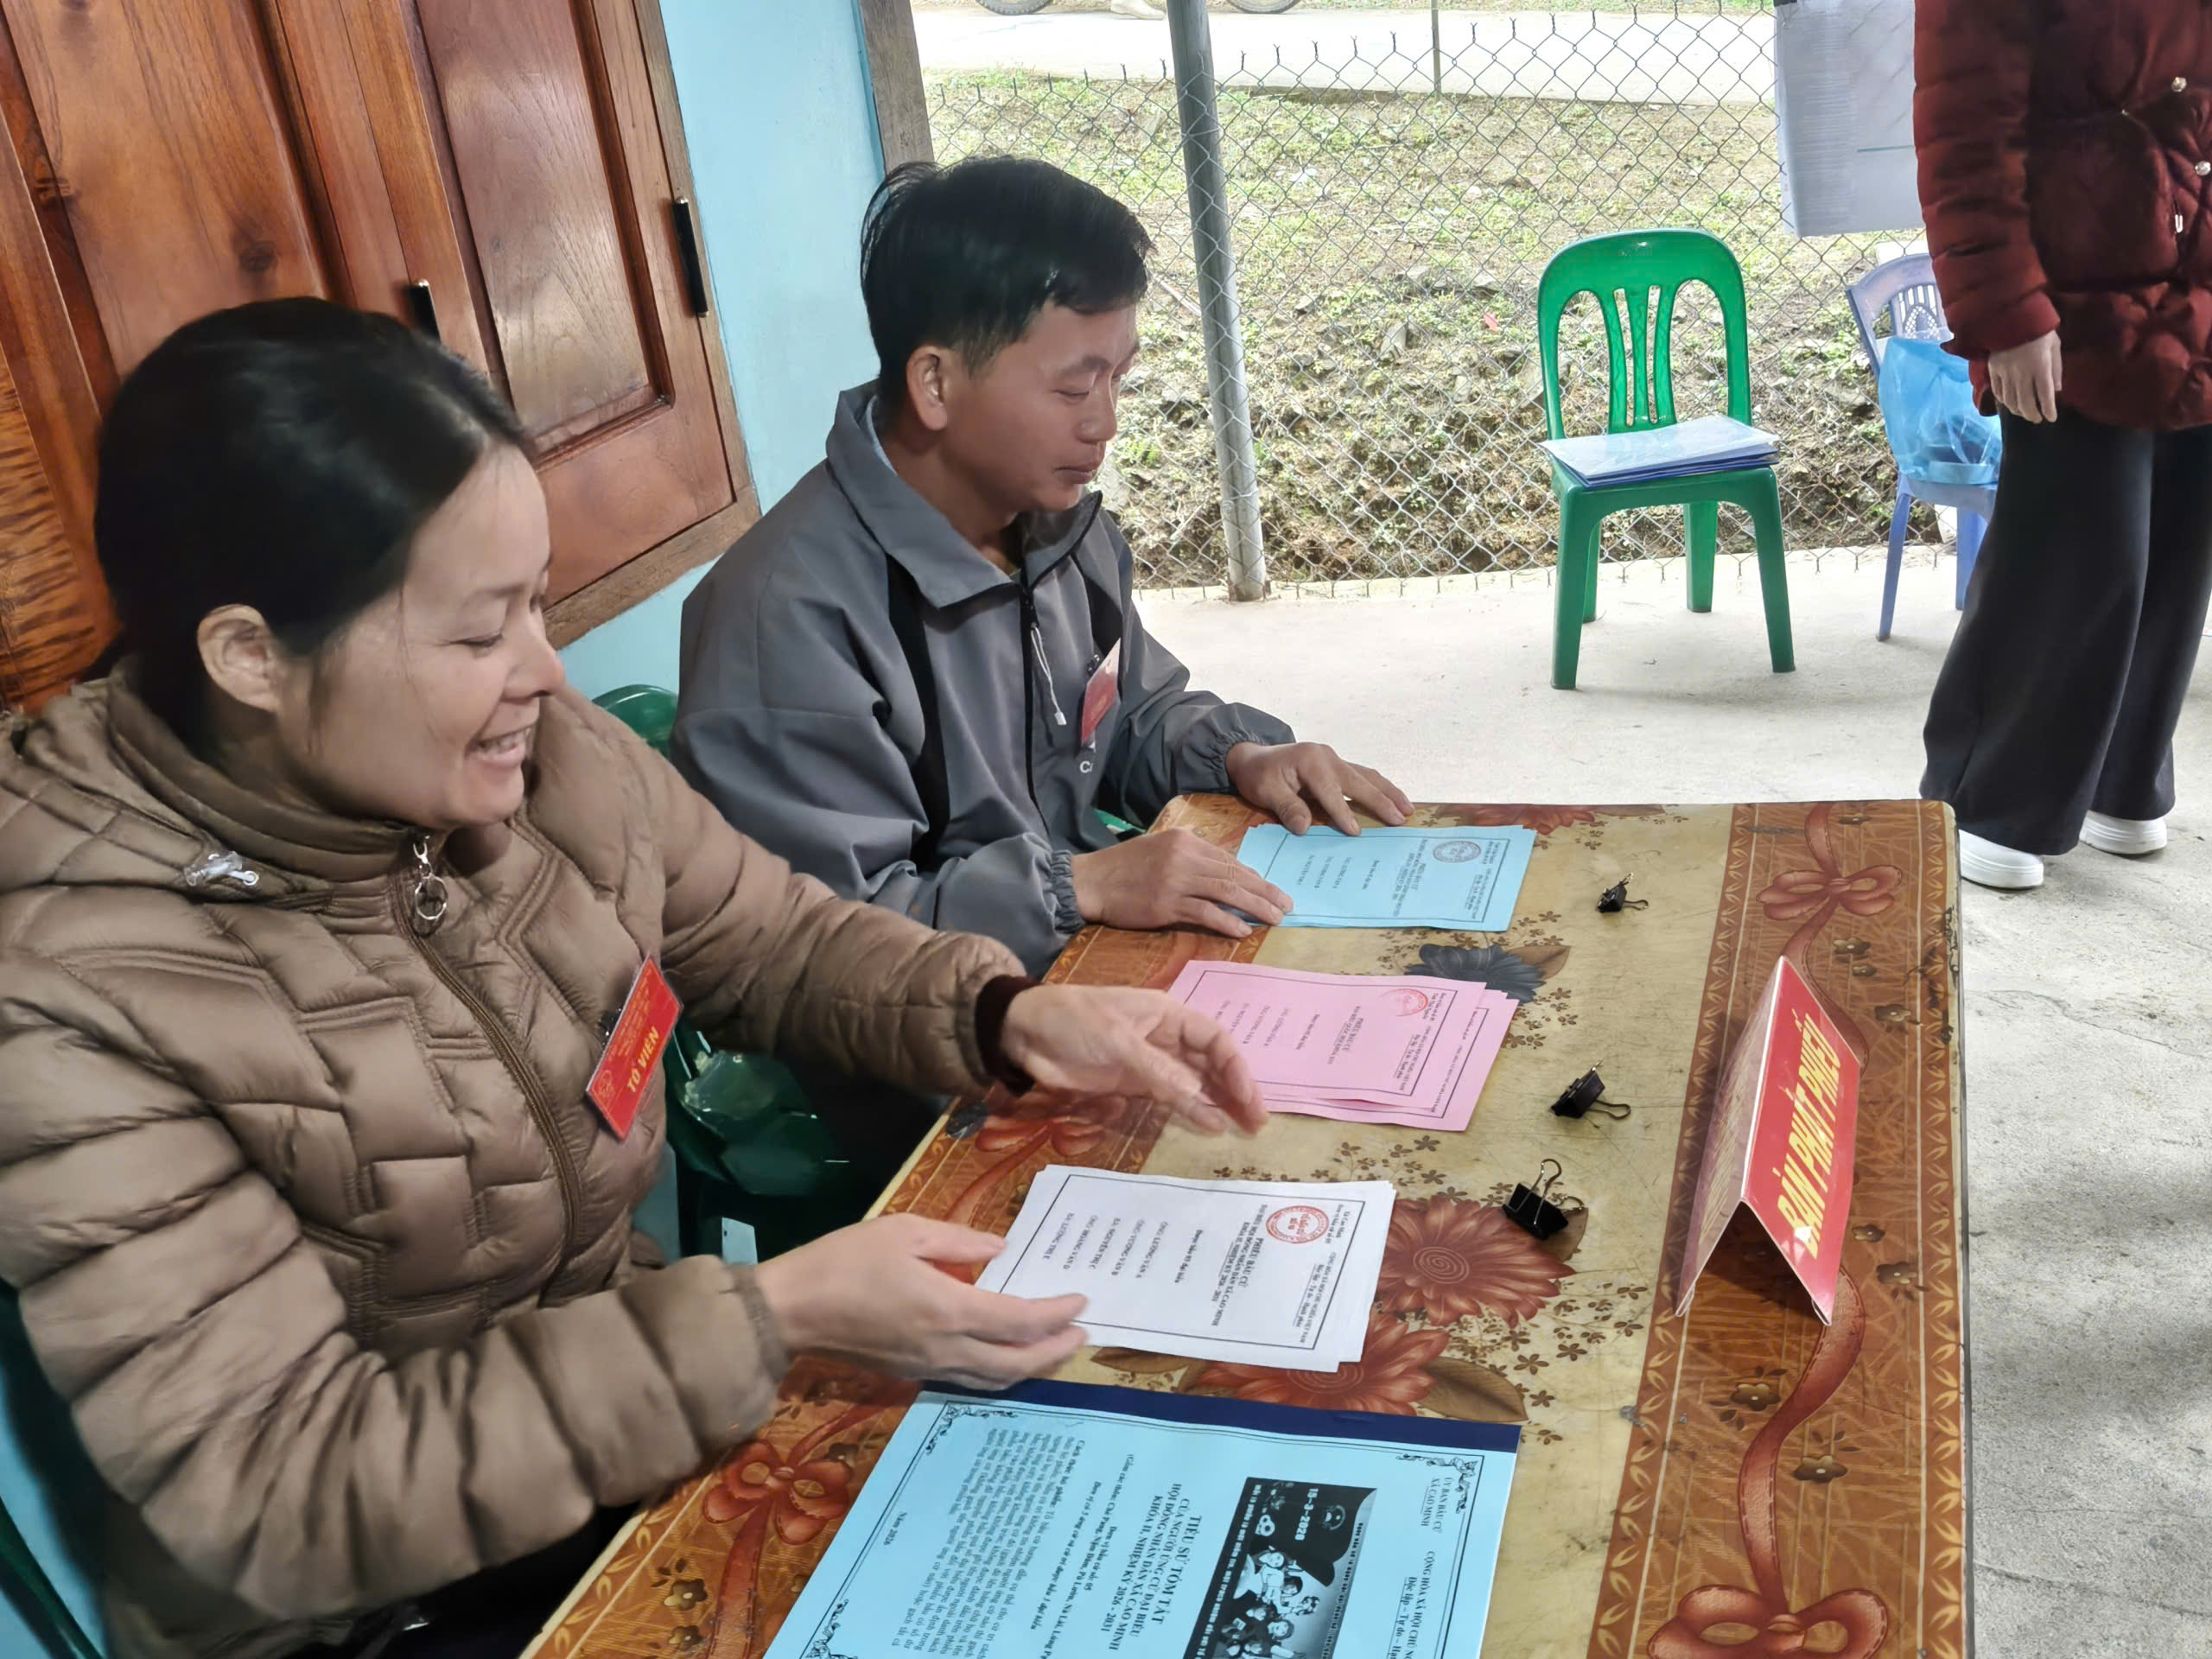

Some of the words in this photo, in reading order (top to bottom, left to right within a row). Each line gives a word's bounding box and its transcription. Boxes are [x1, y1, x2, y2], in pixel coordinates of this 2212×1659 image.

[1792, 1008, 1840, 1122] PHIẾU
[1785, 1082, 1834, 1192] PHÁT
[1772, 1154, 1825, 1259] BÀN
[1431, 1478, 1440, 1488] XÃ
[1443, 1477, 1453, 1486] ỦY
[1166, 1483, 1182, 1501] HỘI
[1427, 1489, 1436, 1504] CAO
[1440, 1488, 1449, 1503] BAN
[1143, 1495, 1165, 1522] KHÓA
[1155, 1503, 1175, 1529] ĐỒNG
[1174, 1497, 1192, 1517] CỦA
[1421, 1505, 1431, 1526] MINH
[1435, 1504, 1446, 1519] BẦU
[1161, 1520, 1183, 1551] NGƯỜI
[1180, 1514, 1205, 1544] TIỂU
[1432, 1520, 1443, 1533] CỬ
[1126, 1536, 1147, 1567] NHIỆM
[1145, 1532, 1165, 1558] NHÂN
[1154, 1554, 1170, 1574] ỨNG
[1173, 1546, 1193, 1564] SỬ
[1422, 1550, 1434, 1575] CỘNG
[1120, 1570, 1136, 1584] KỲ
[1135, 1560, 1154, 1580] DÂN
[1129, 1582, 1146, 1596] XÃ
[1146, 1576, 1163, 1592] CỬ
[1161, 1565, 1185, 1595] TÓM
[1404, 1576, 1416, 1591] Độc
[1419, 1577, 1430, 1596] HÒA
[1113, 1586, 1128, 1605] 2026
[1137, 1592, 1154, 1610] ĐẠI
[1400, 1592, 1413, 1605] lập
[1415, 1598, 1427, 1610] XÃ
[1119, 1598, 1137, 1619] CAO
[1150, 1598, 1173, 1624] TẮT
[1102, 1612, 1117, 1631] 2031
[1128, 1612, 1147, 1637] BIỂU
[1395, 1613, 1408, 1625] Tự
[1409, 1611, 1422, 1628] HỘI
[1108, 1622, 1128, 1650] MINH
[1395, 1626, 1405, 1637] do
[1407, 1630, 1418, 1649] CHỦ
